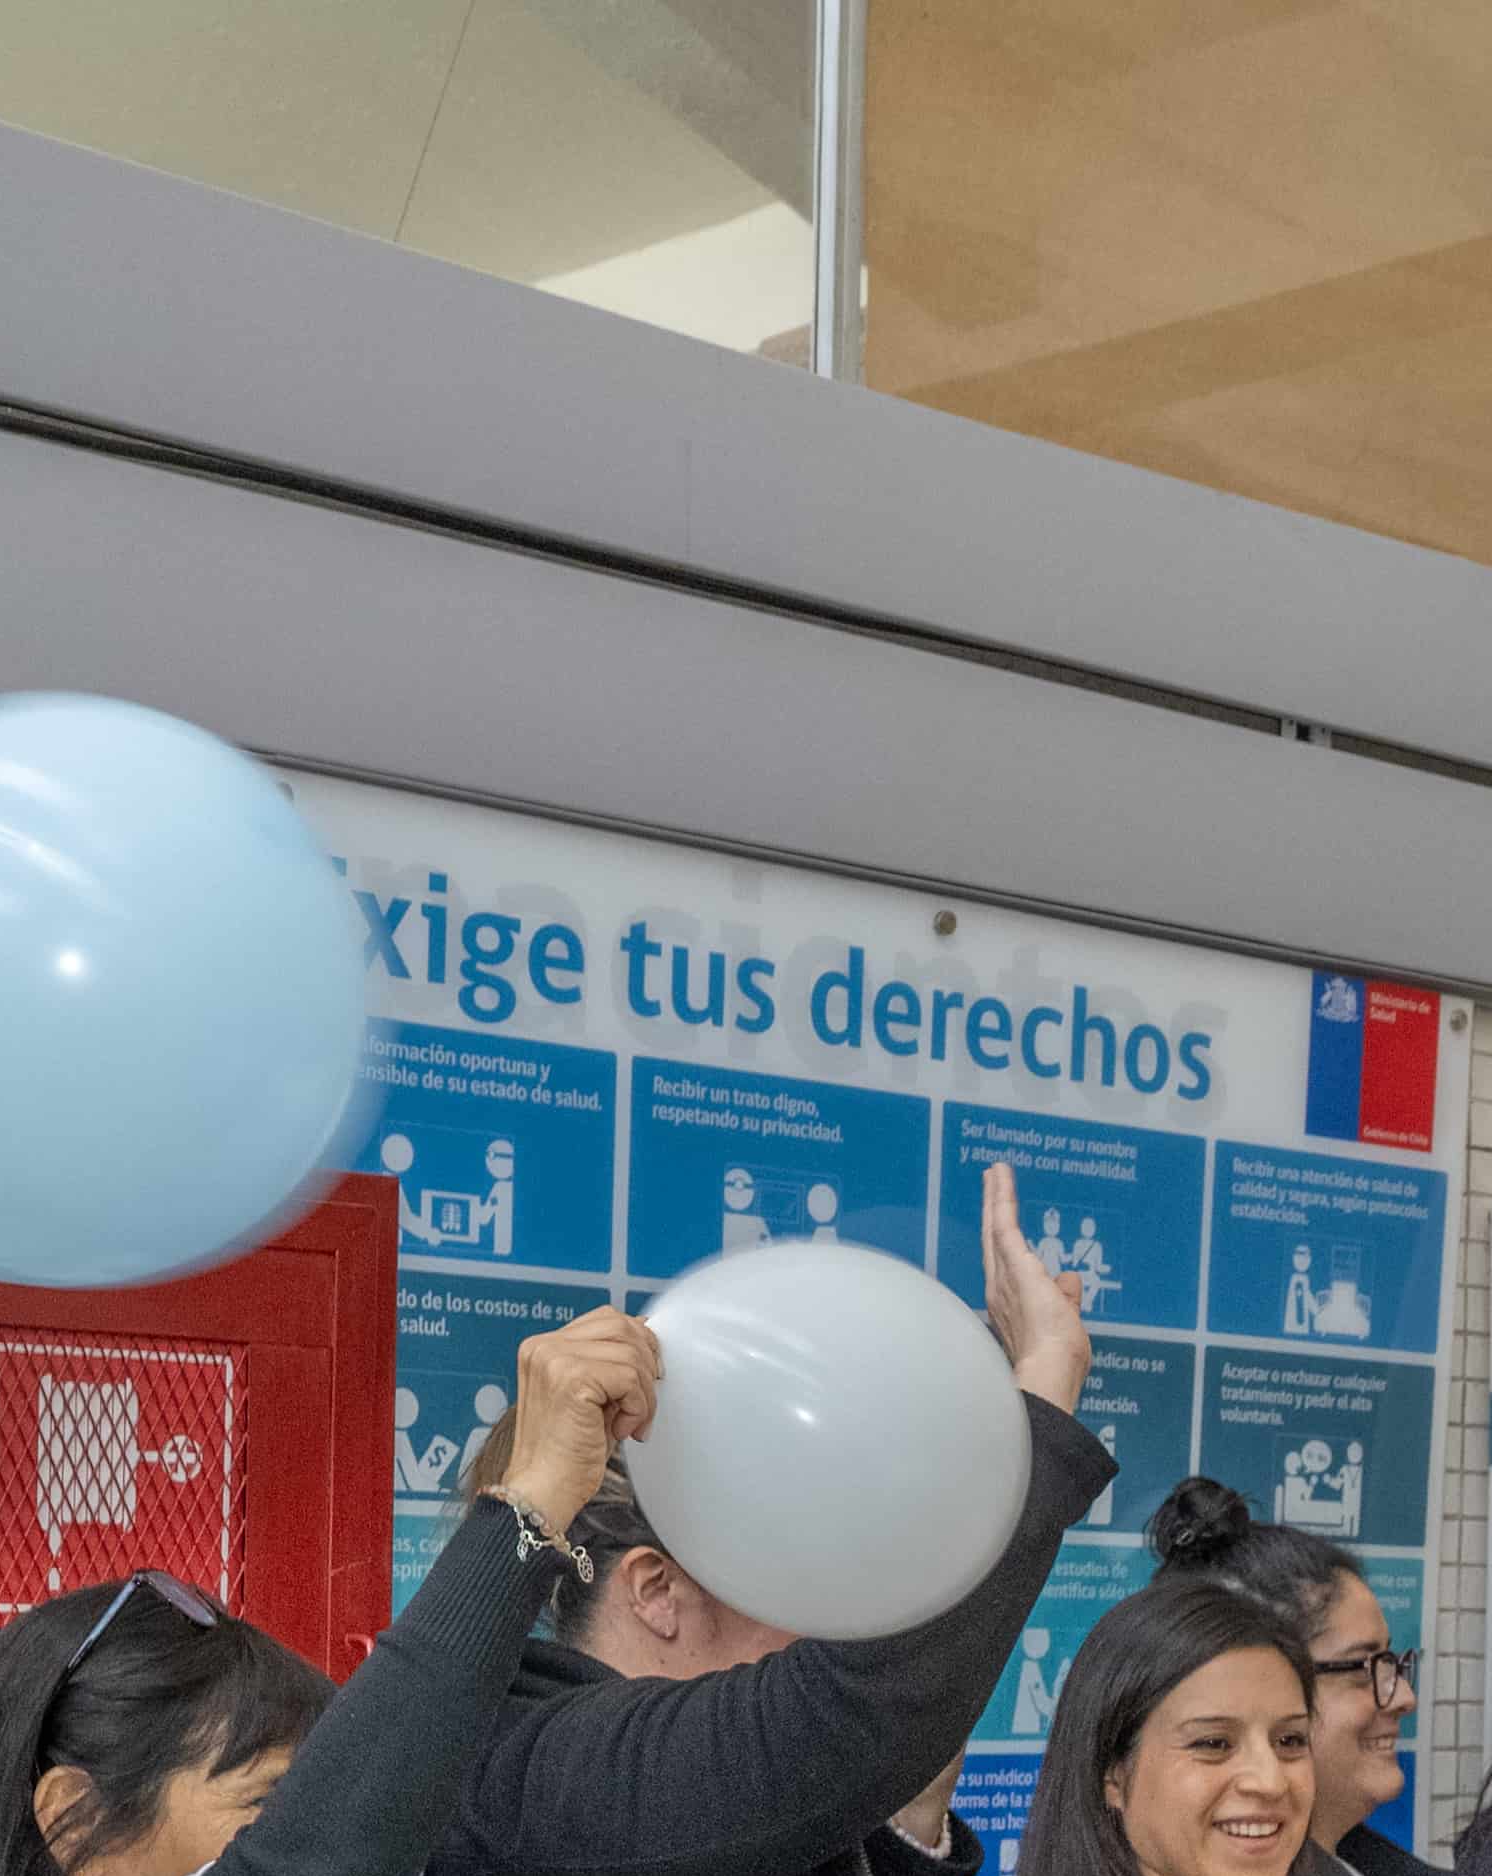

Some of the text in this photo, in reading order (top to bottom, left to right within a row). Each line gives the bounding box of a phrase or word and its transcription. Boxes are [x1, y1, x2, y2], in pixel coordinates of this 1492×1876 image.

[331, 857, 1212, 1100] xige tus derechos
[368, 1035, 552, 1083] formación oportuna y
[359, 1063, 603, 1111] ensible de su estado de salud.
[652, 1075, 820, 1118] Recibir un trato digno,
[652, 1104, 844, 1143] respetando su privacidad.
[1044, 1134, 1068, 1152] por
[1070, 1138, 1085, 1152] su
[397, 1288, 574, 1321] do de los costos de su
[400, 1316, 449, 1336] salud.
[1043, 1582, 1097, 1600] entífica
[968, 1774, 982, 1786] su
[985, 1768, 1033, 1787] médico
[991, 1792, 1008, 1808] de
[1010, 1791, 1022, 1807] la
[991, 1818, 1005, 1831] su
